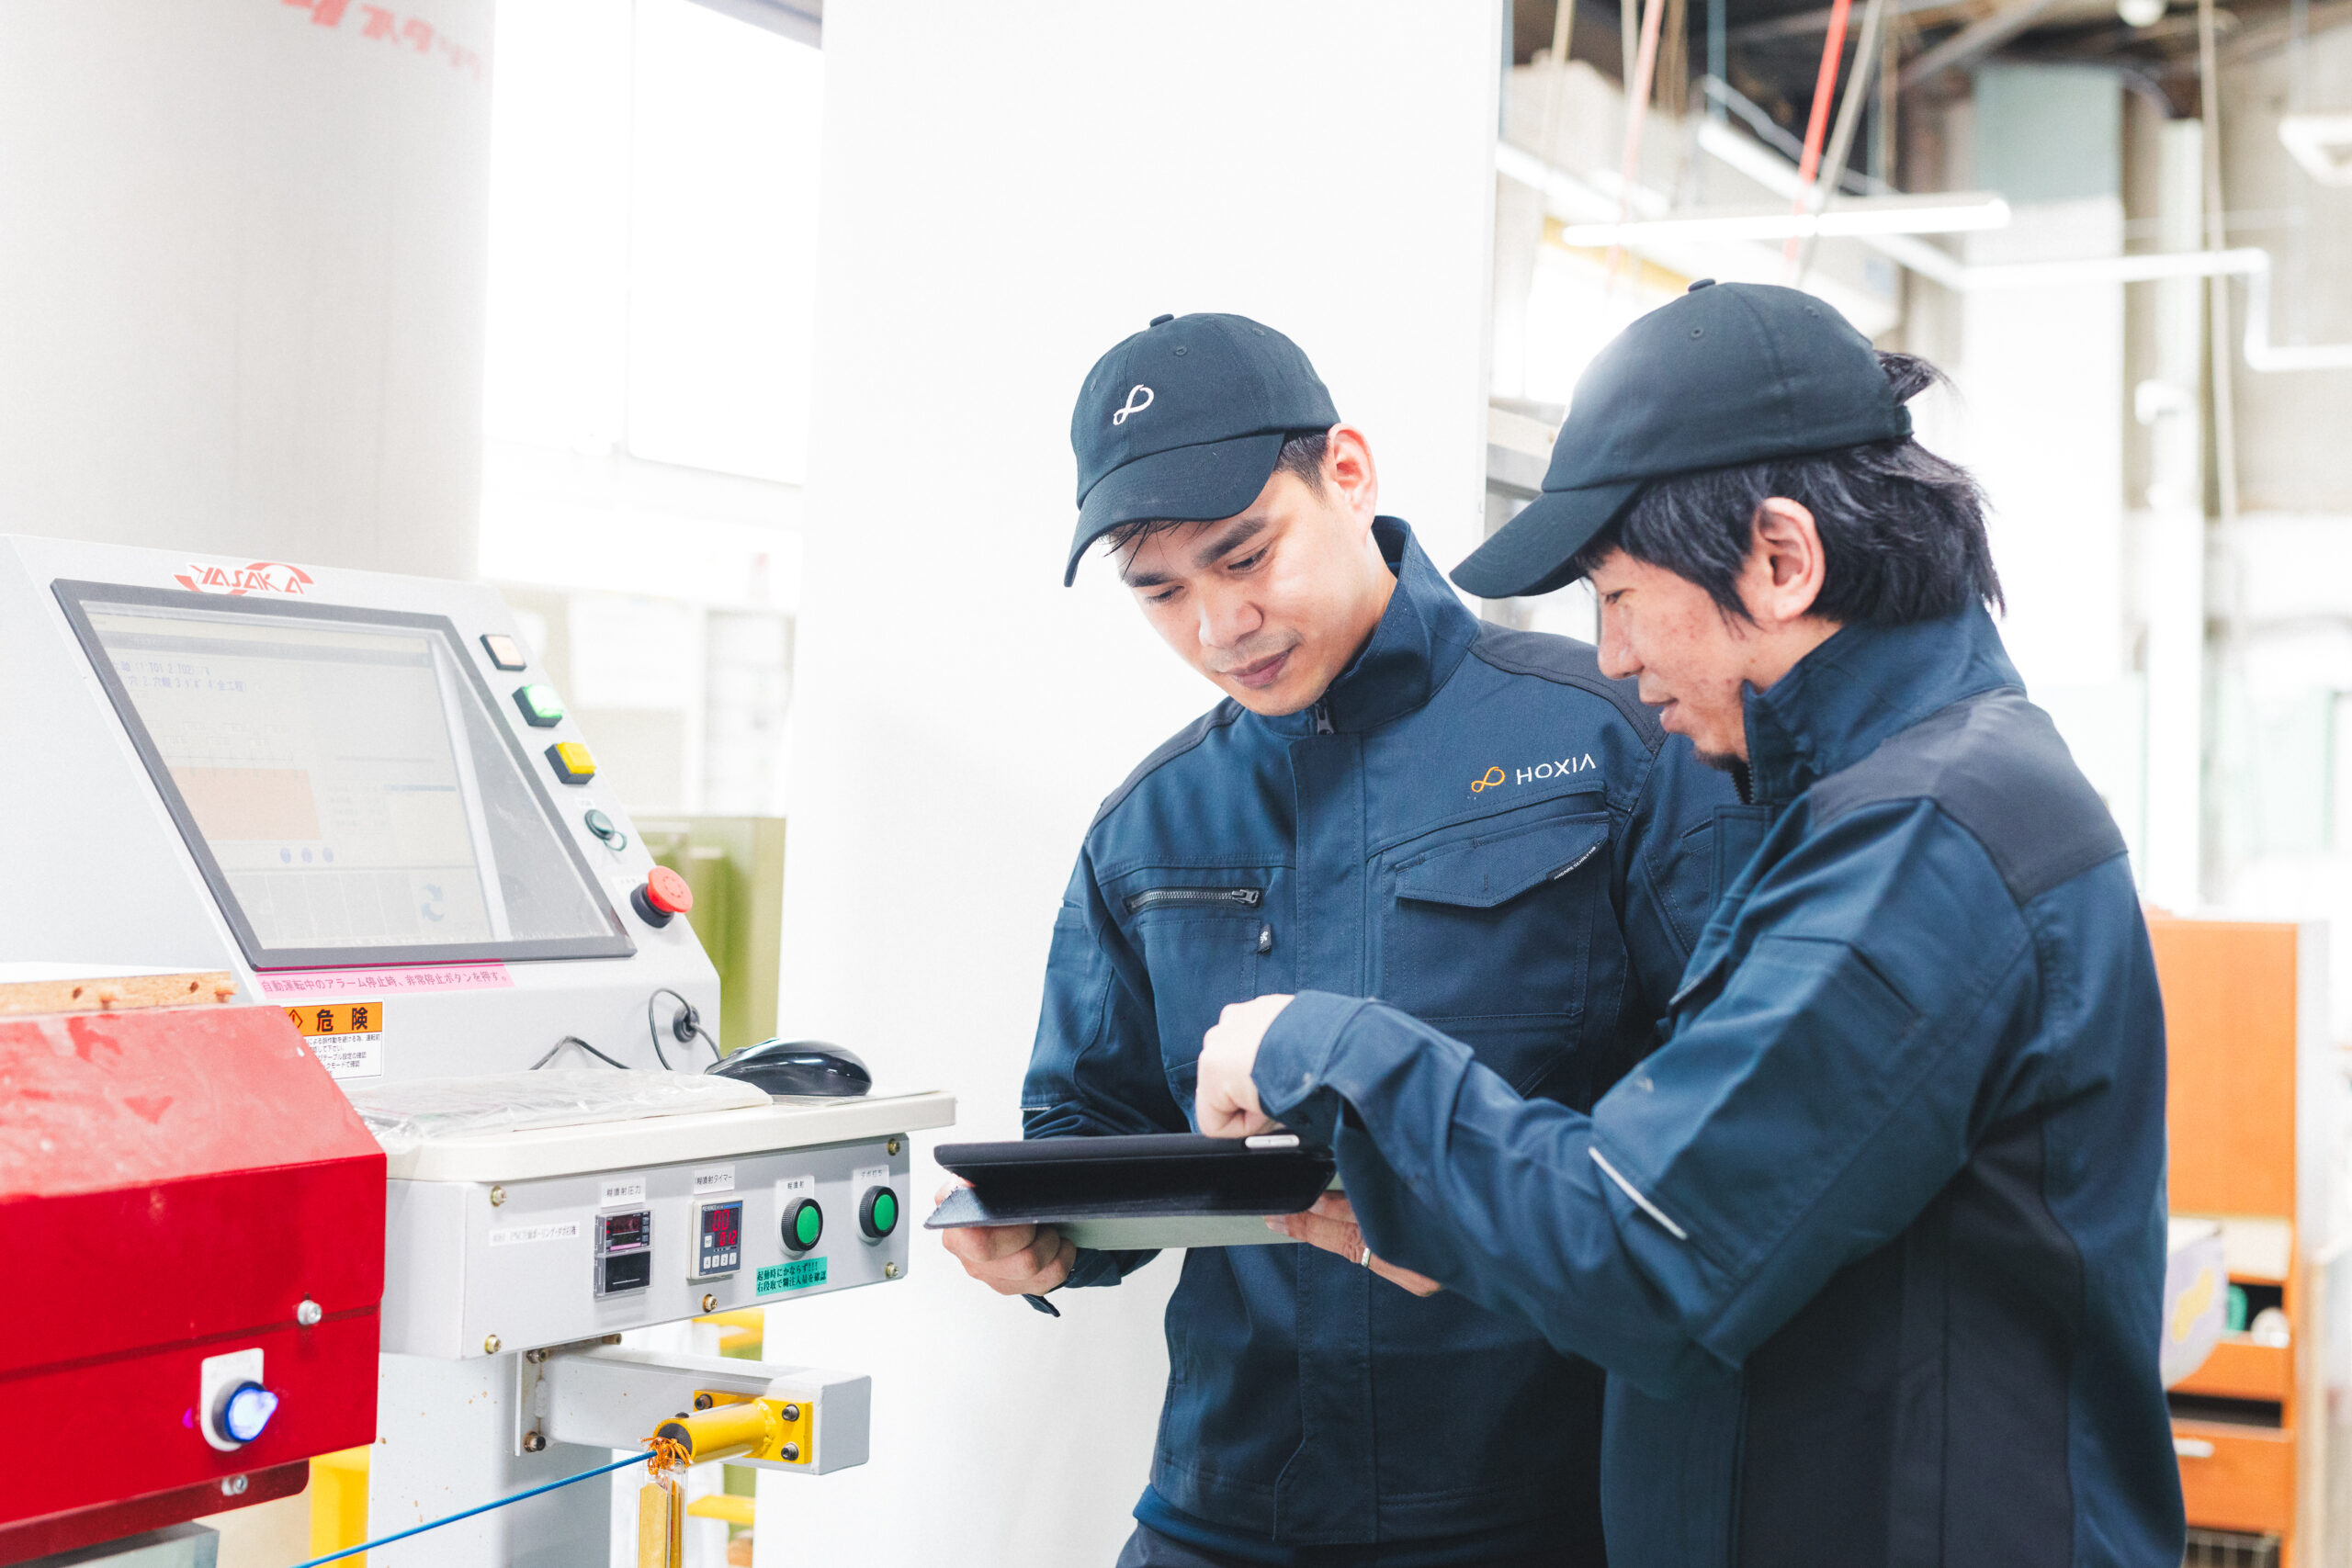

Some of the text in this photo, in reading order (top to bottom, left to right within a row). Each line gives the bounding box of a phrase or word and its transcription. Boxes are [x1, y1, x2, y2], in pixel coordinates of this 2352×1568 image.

[188, 564, 304, 594] YASAKA
[1516, 753, 1597, 784] HOXIA
[261, 971, 507, 993] 自動運転中のアラーム停止時、非常停止ボタンを押す。
